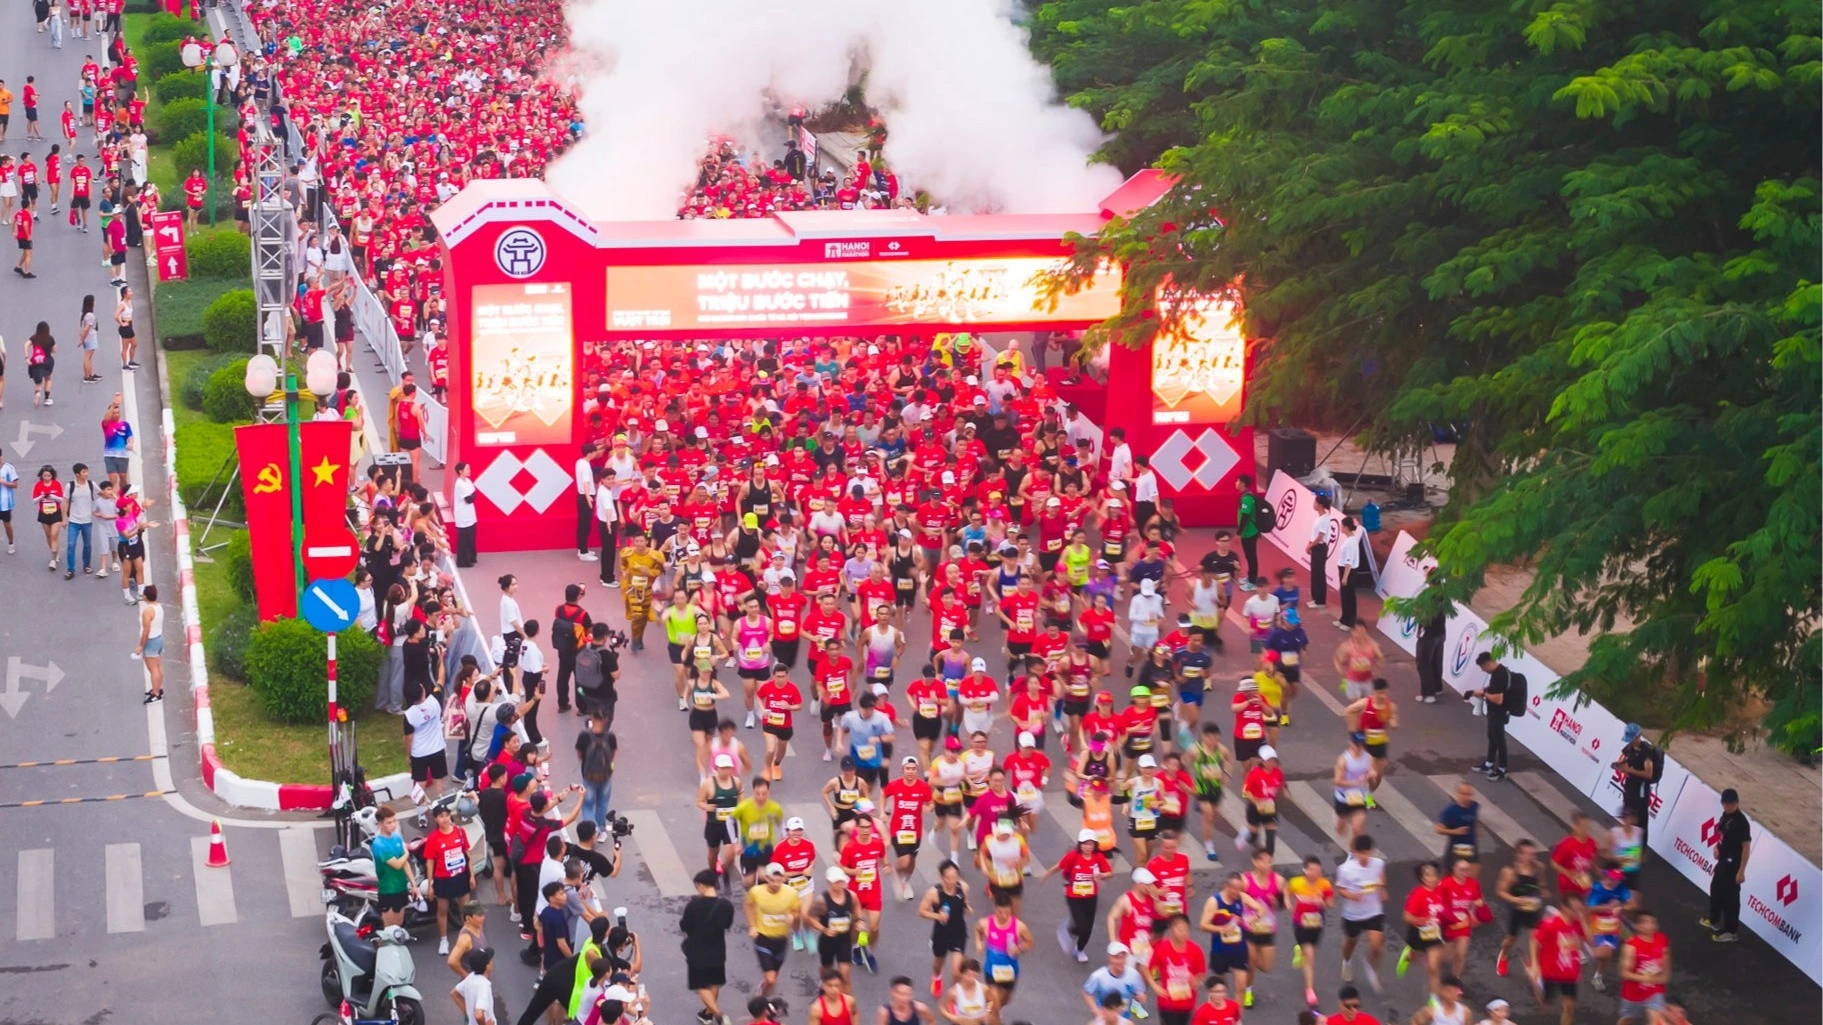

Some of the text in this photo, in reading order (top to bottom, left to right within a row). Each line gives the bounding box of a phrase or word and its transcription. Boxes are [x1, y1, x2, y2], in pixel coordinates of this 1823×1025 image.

[842, 242, 870, 250] HANOI
[697, 270, 849, 292] MỘT BƯỚC CHẠY,
[697, 291, 750, 313] TRIỆU
[752, 291, 805, 310] BƯỚC
[1564, 715, 1583, 736] HANOI
[1673, 836, 1715, 876] TECHCOMBA
[1747, 894, 1802, 945] TECHCOMBANK
